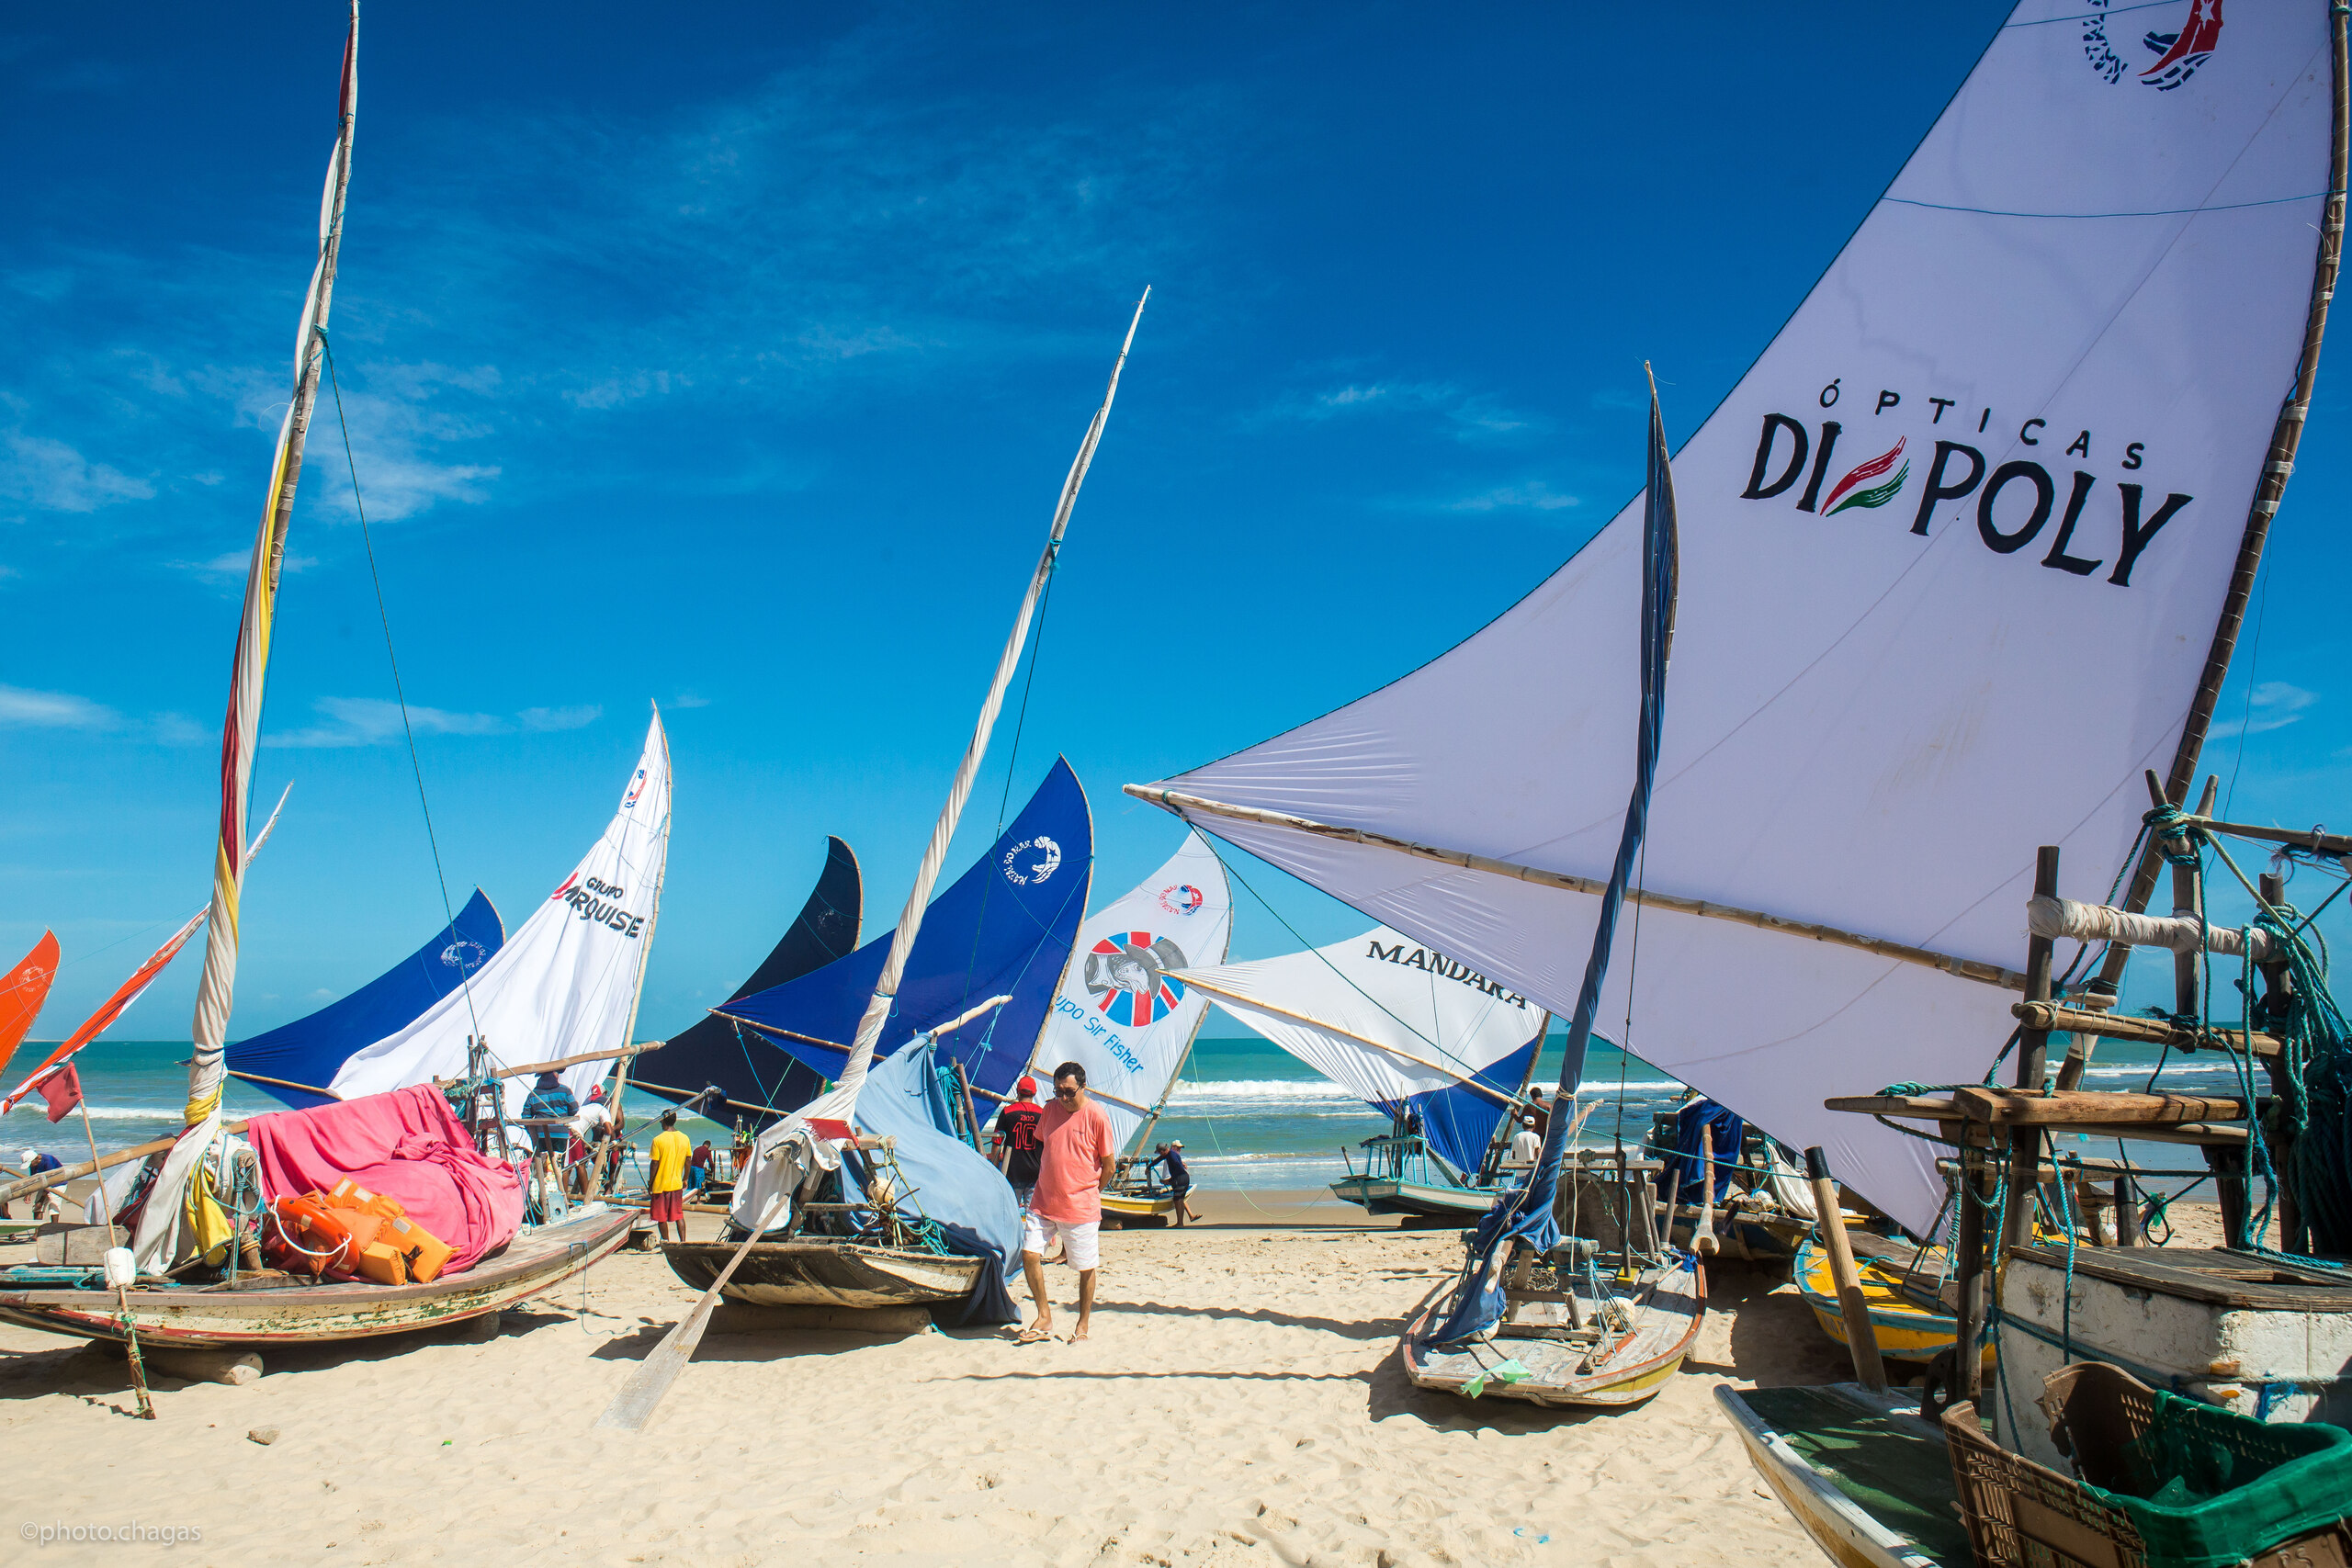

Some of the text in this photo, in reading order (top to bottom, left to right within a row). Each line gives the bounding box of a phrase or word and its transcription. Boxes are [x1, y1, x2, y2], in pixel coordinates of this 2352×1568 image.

[1819, 378, 2144, 469] ÓPTICAS
[1739, 412, 2194, 587] DI POLY
[586, 876, 625, 899] GRUPO
[1083, 1016, 1107, 1036] Sir
[1103, 1033, 1144, 1074] Fisher
[1012, 1122, 1037, 1150] 10
